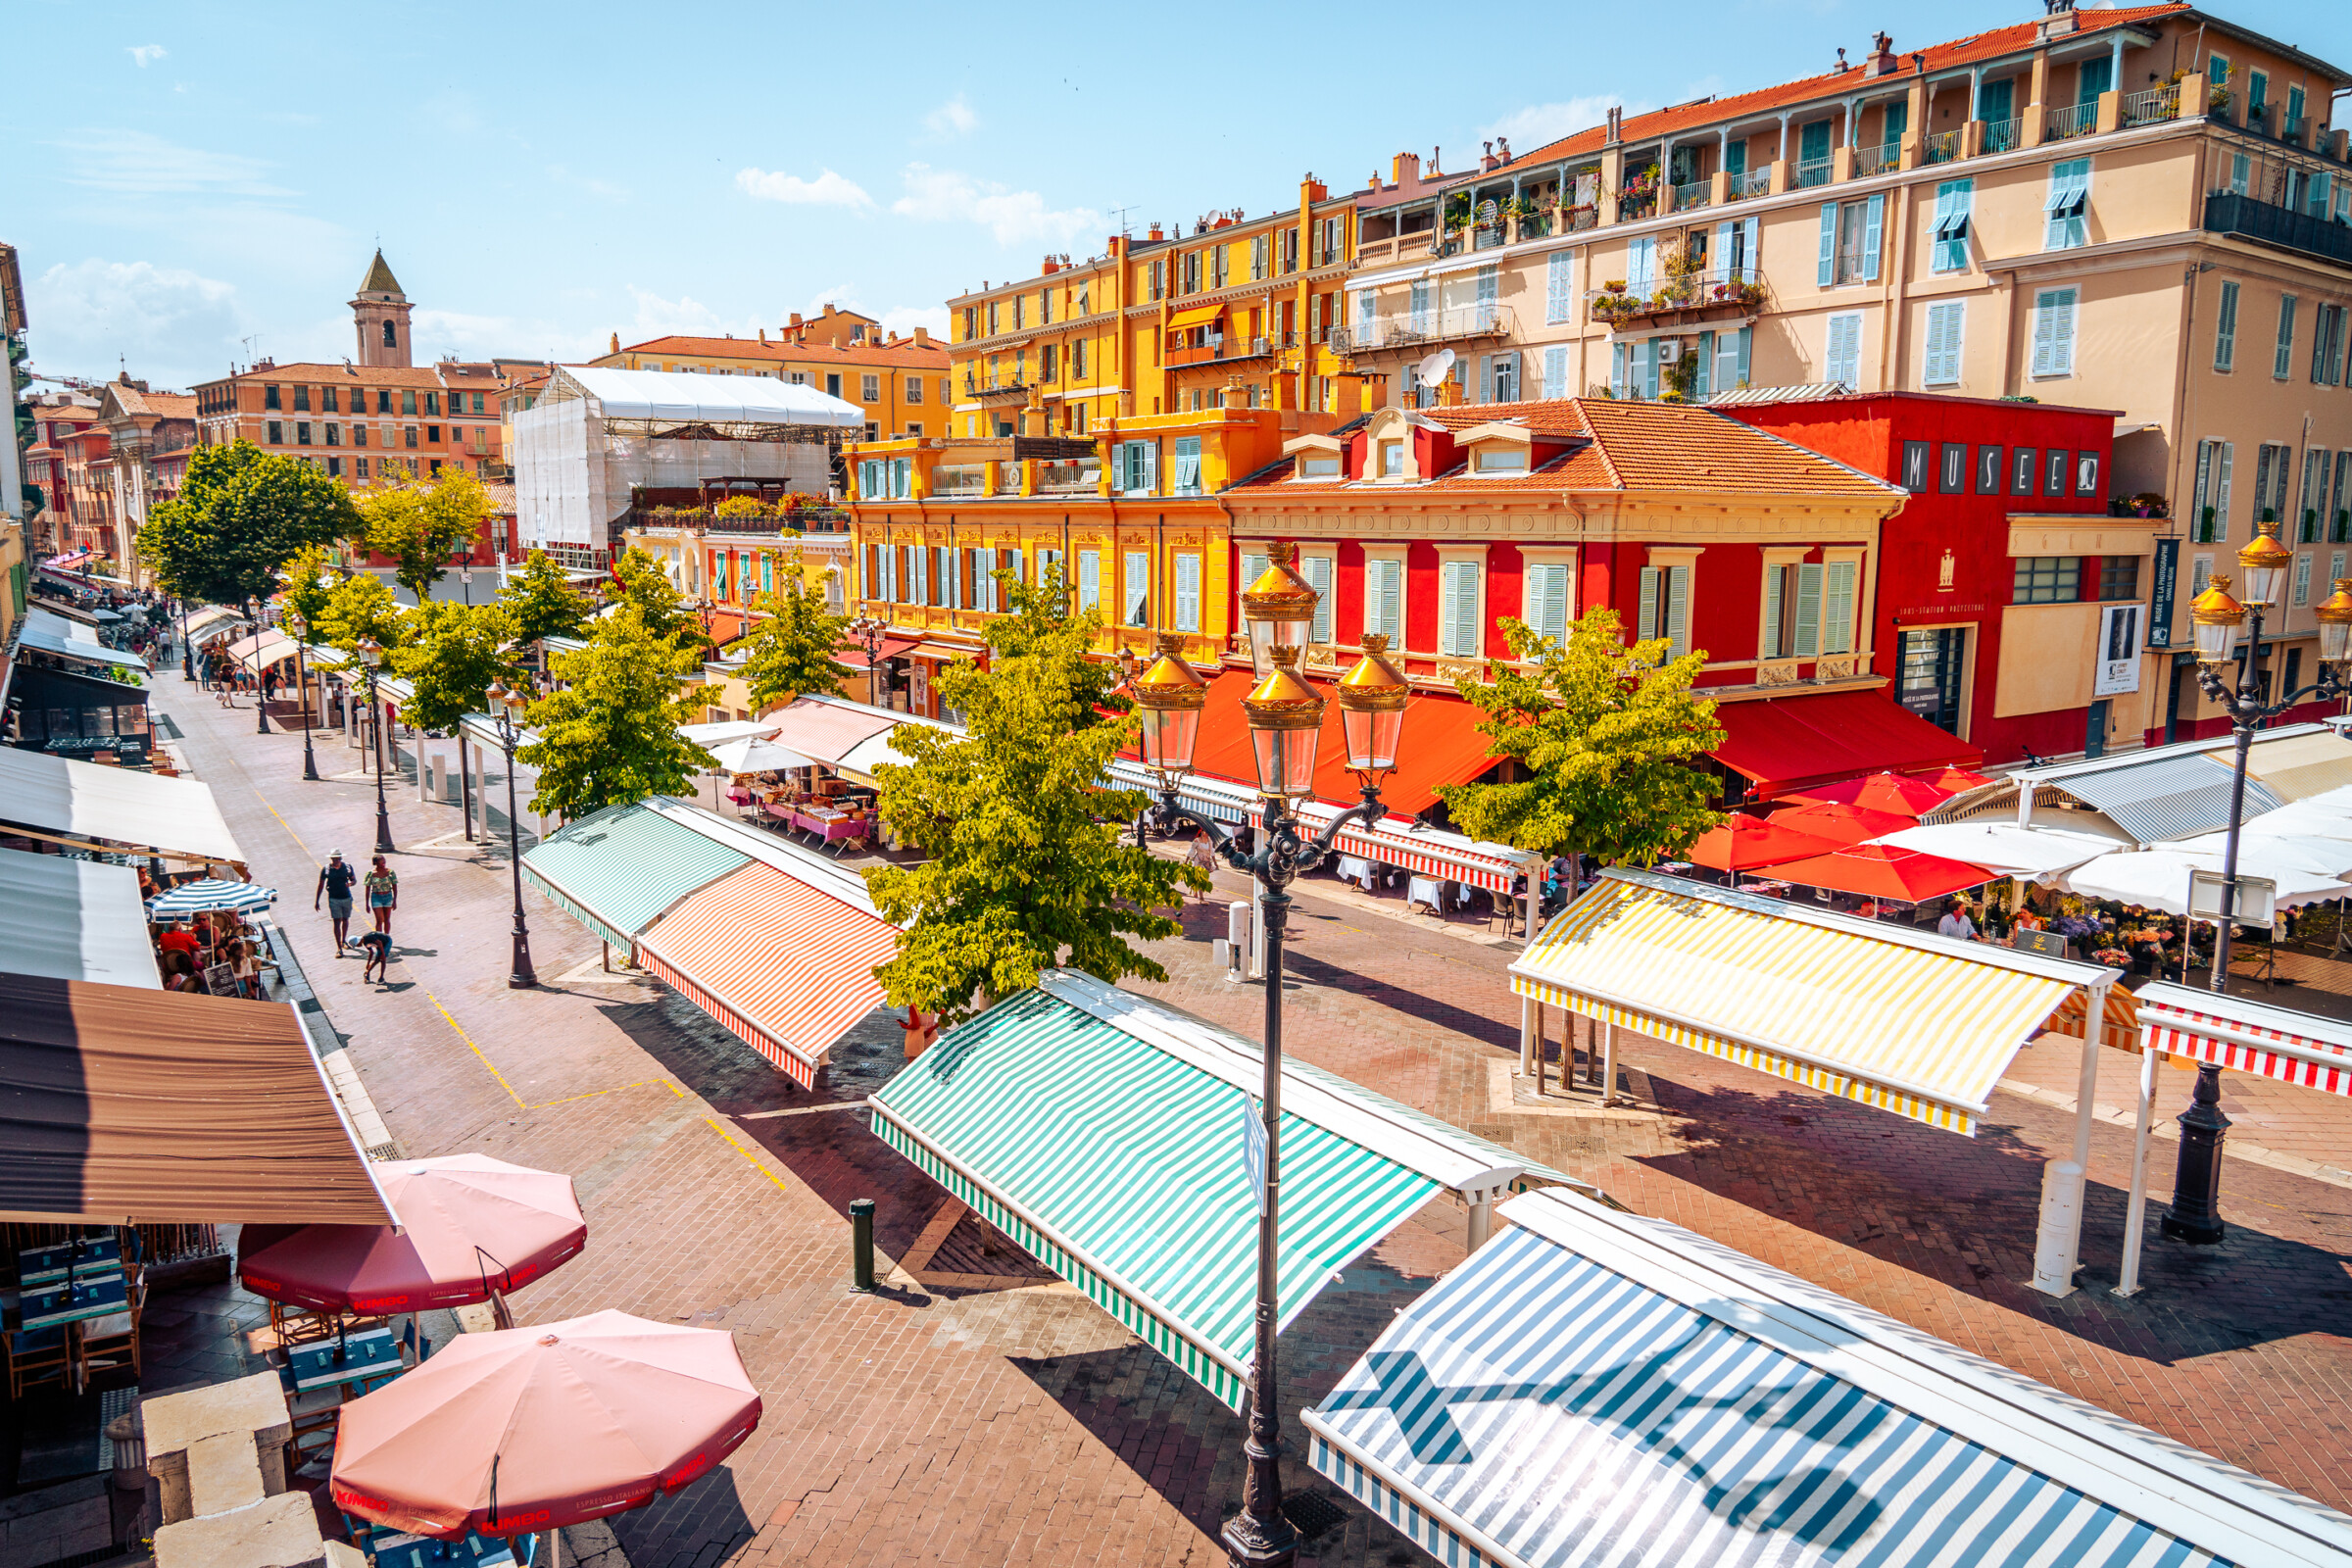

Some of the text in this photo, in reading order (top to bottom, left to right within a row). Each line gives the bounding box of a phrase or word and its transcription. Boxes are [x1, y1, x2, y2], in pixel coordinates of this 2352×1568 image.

[1909, 448, 2061, 491] MUSEE
[2154, 544, 2169, 622] MUSÉE DE LA PHOTOGRAPHIE
[243, 1274, 281, 1293] KIMBO
[428, 1288, 459, 1298] ESPRESSO
[354, 1295, 409, 1311] KIMBO
[666, 1452, 706, 1489] KIMBO
[336, 1490, 389, 1512] KIMBO
[576, 1486, 652, 1509] ESPRESSO ITALIANO
[408, 1506, 436, 1521] ESPRESSO
[481, 1509, 551, 1533] KIMBO
